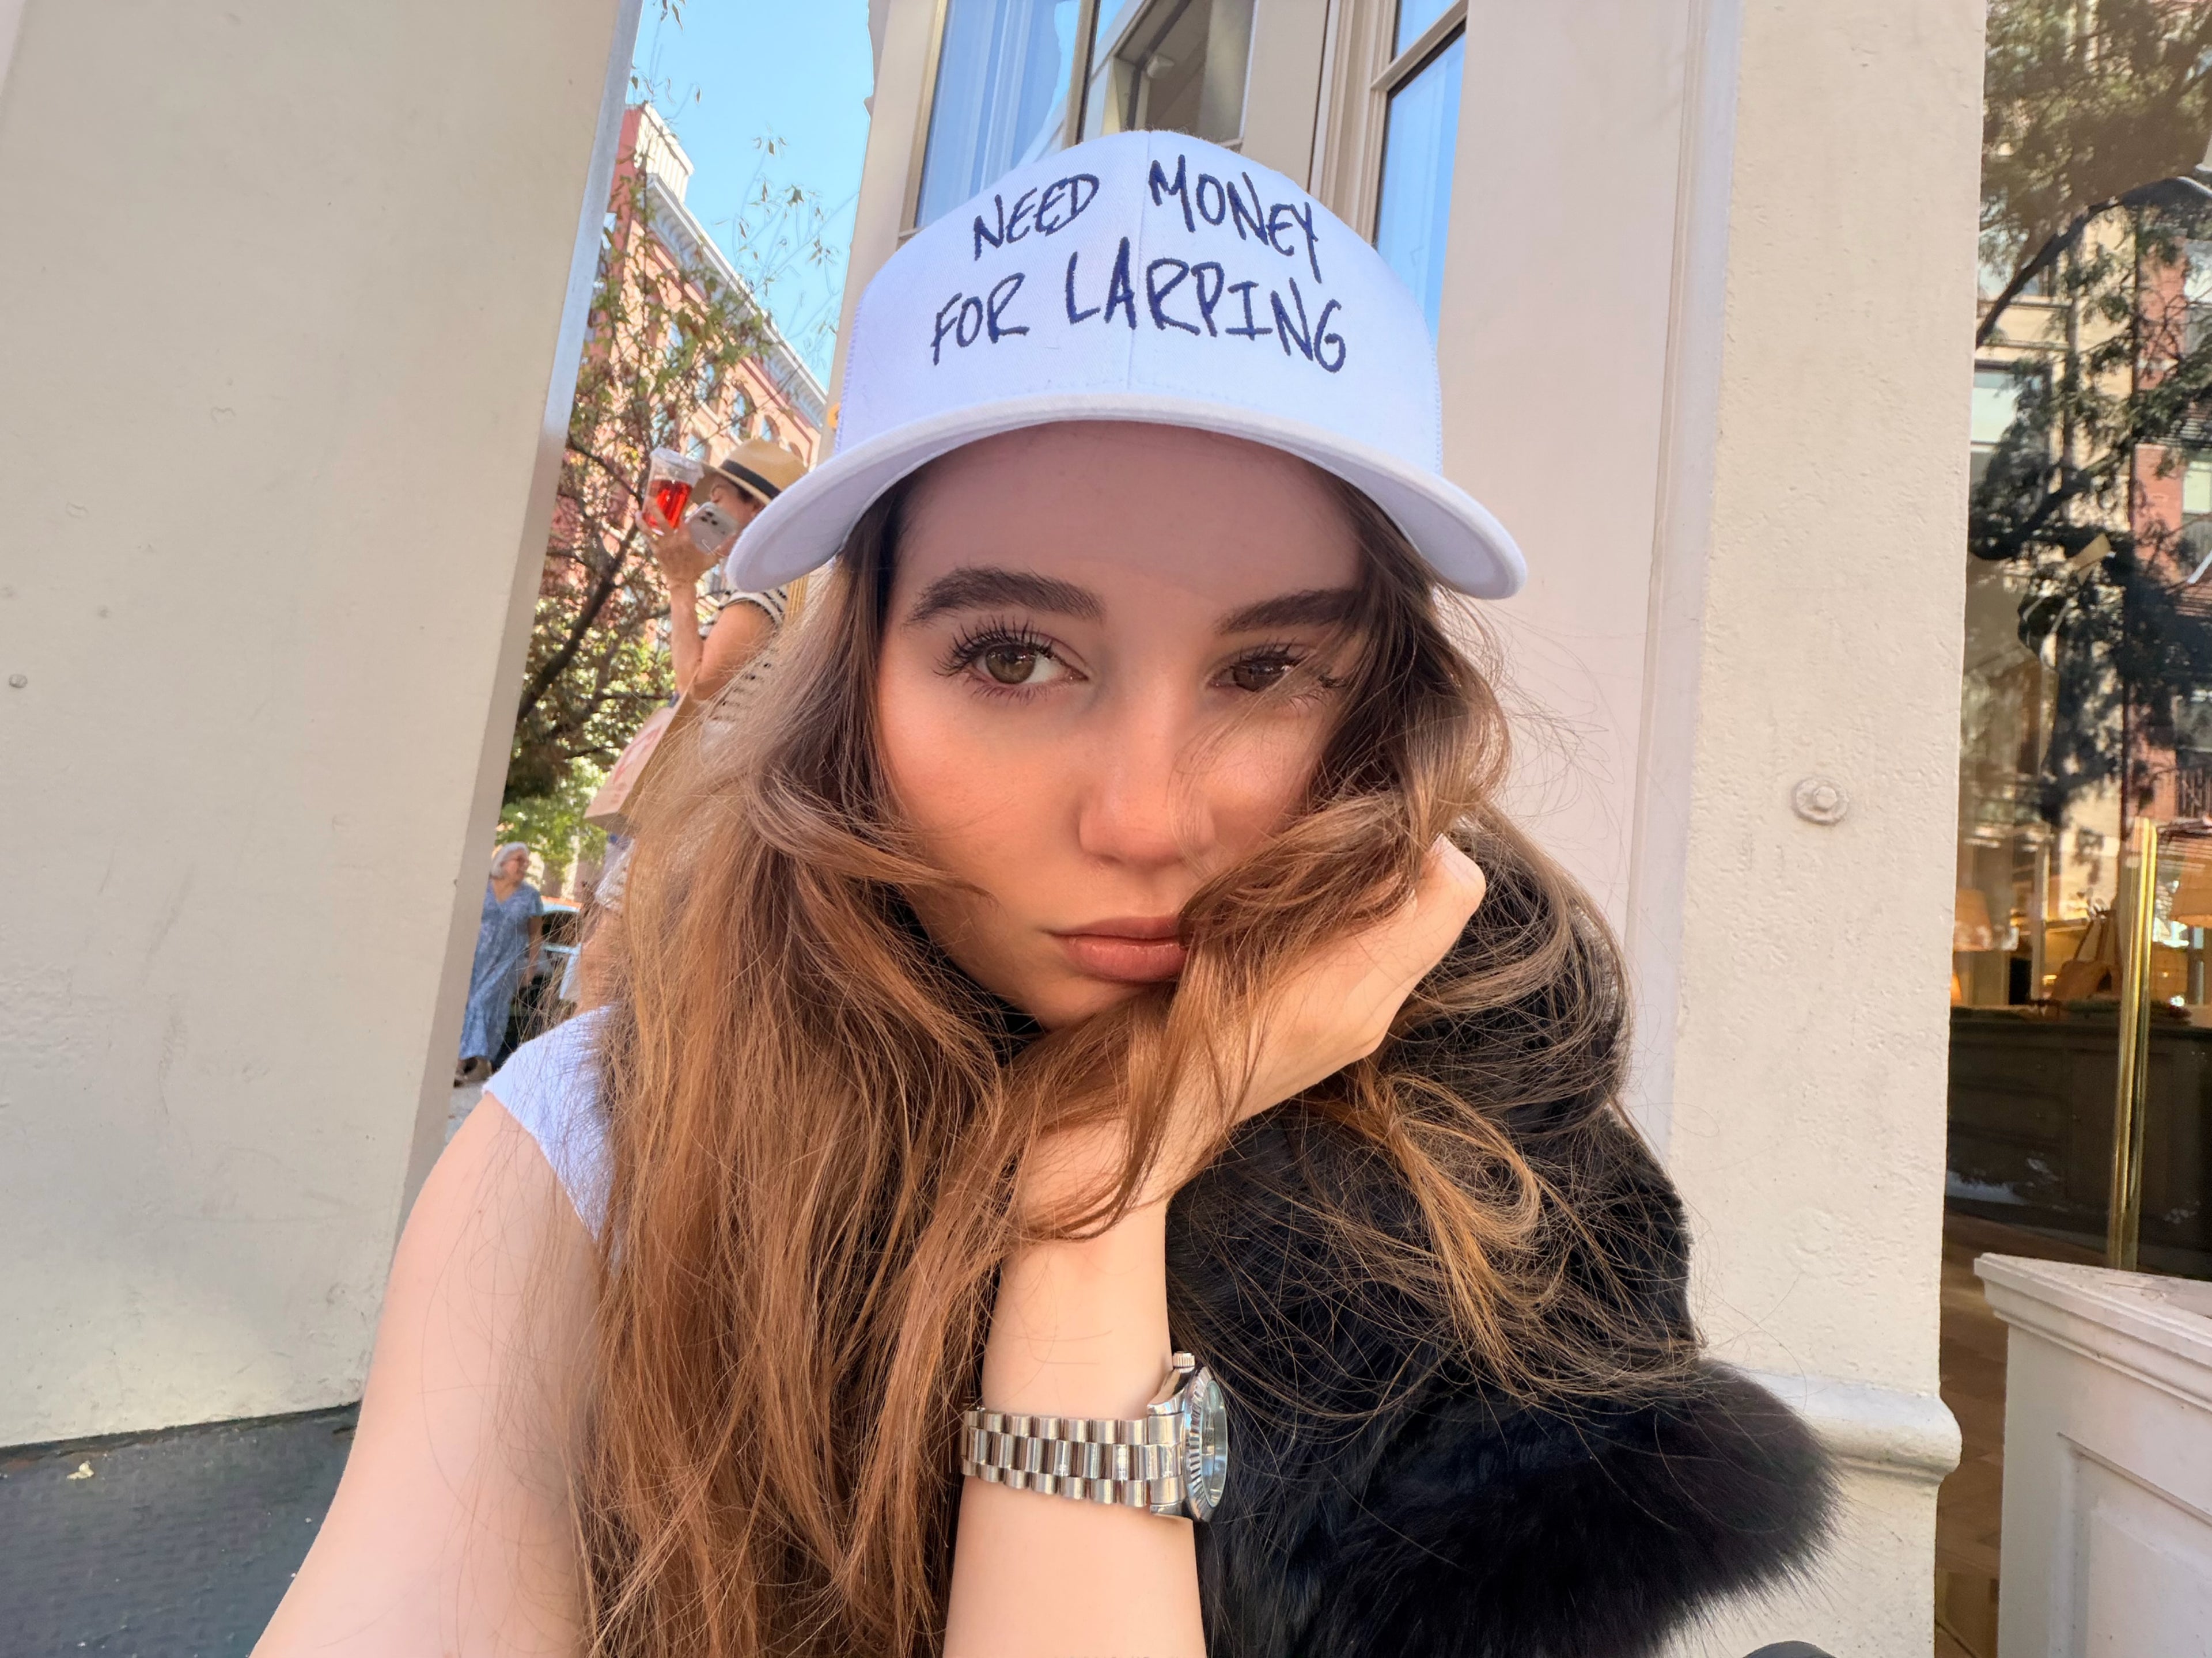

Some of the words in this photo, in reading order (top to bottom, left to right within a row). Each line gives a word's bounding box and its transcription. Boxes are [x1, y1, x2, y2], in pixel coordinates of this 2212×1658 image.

[974, 173, 1100, 261] NEED
[1147, 154, 1322, 284] MONEY
[930, 272, 1030, 366] FOR
[1065, 236, 1346, 374] LARPING
